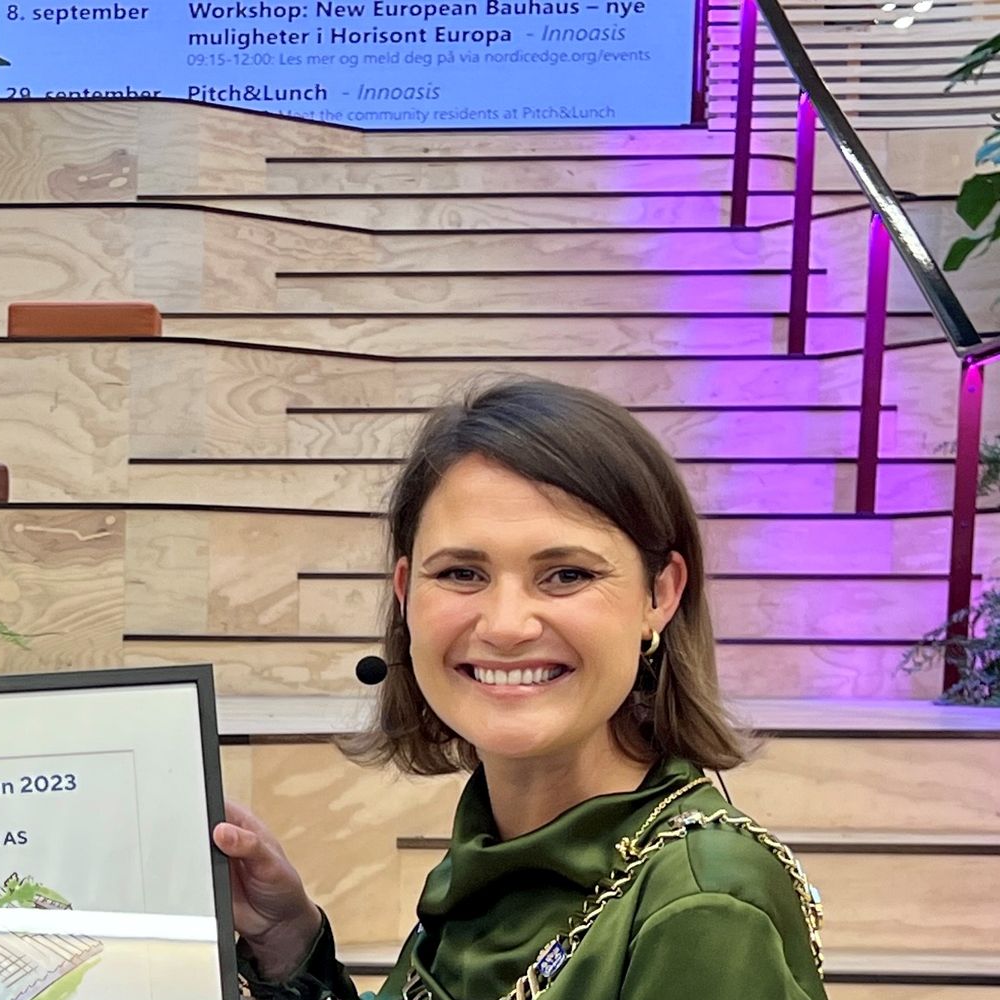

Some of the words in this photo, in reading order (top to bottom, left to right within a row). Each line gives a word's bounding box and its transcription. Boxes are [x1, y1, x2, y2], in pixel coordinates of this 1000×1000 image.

[7, 4, 25, 21] 8.
[32, 3, 149, 25] september
[188, 1, 308, 23] Workshop:
[316, 1, 365, 17] New
[374, 0, 477, 21] European
[486, 0, 580, 15] Bauhaus
[606, 0, 646, 19] nye
[189, 28, 310, 50] muligheter
[317, 27, 323, 44] i
[331, 26, 428, 44] Horisont
[435, 25, 512, 47] Europa
[541, 24, 626, 42] Innoasis
[280, 53, 302, 65] Les
[307, 55, 335, 65] mer
[339, 54, 359, 68] og
[364, 51, 400, 64] meld
[405, 51, 432, 67] deg
[437, 50, 455, 66] på
[460, 50, 480, 63] via
[485, 49, 651, 66] nordicedge.org/events
[188, 84, 327, 102] Pitch&Lunch
[358, 82, 440, 100] Innoasis
[347, 108, 430, 123] community
[434, 106, 500, 120] residents
[503, 108, 517, 119] at
[522, 105, 616, 119] Pitch&Lunch
[21, 774, 77, 793] 2023
[3, 831, 28, 846] AS
